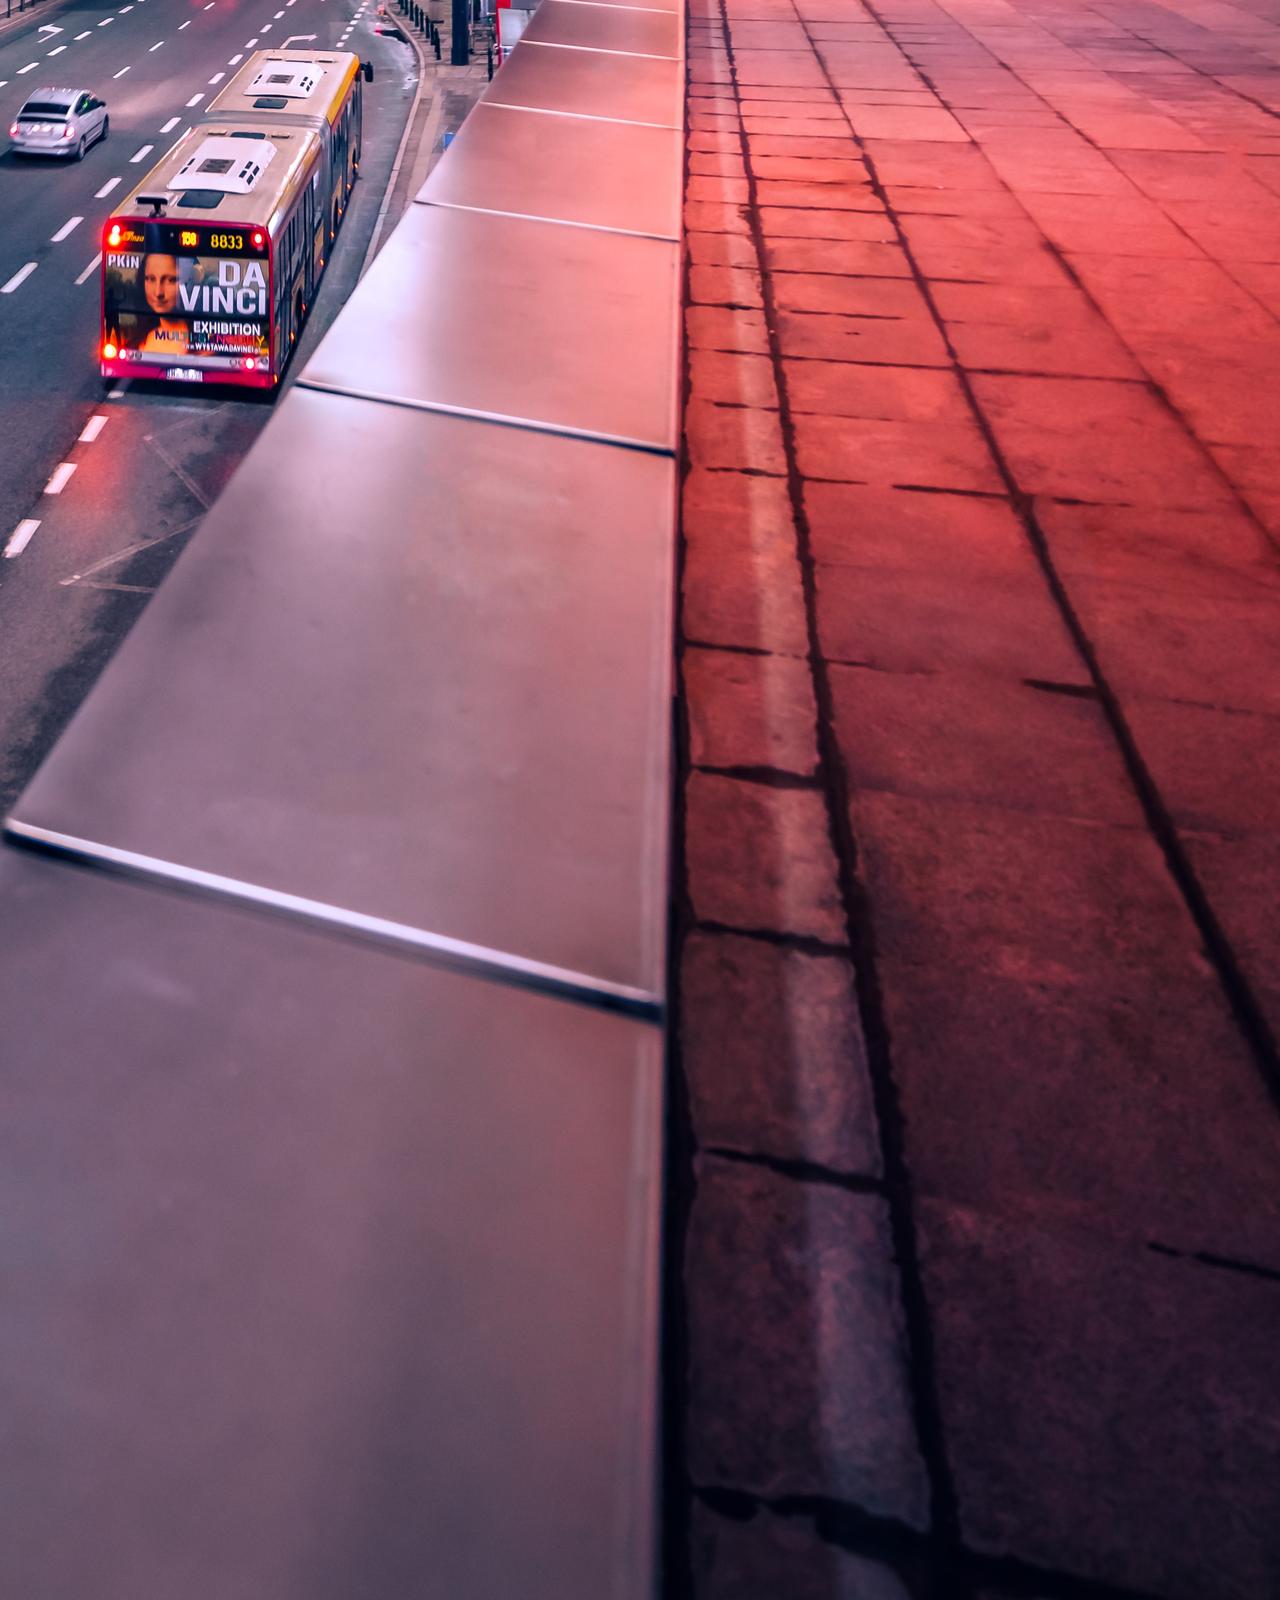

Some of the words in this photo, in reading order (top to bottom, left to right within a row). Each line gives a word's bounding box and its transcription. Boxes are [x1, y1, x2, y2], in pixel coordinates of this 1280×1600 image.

[211, 234, 243, 249] 8833
[219, 261, 266, 288] DA
[179, 284, 266, 316] VINCI
[193, 320, 261, 336] EXHIBITION
